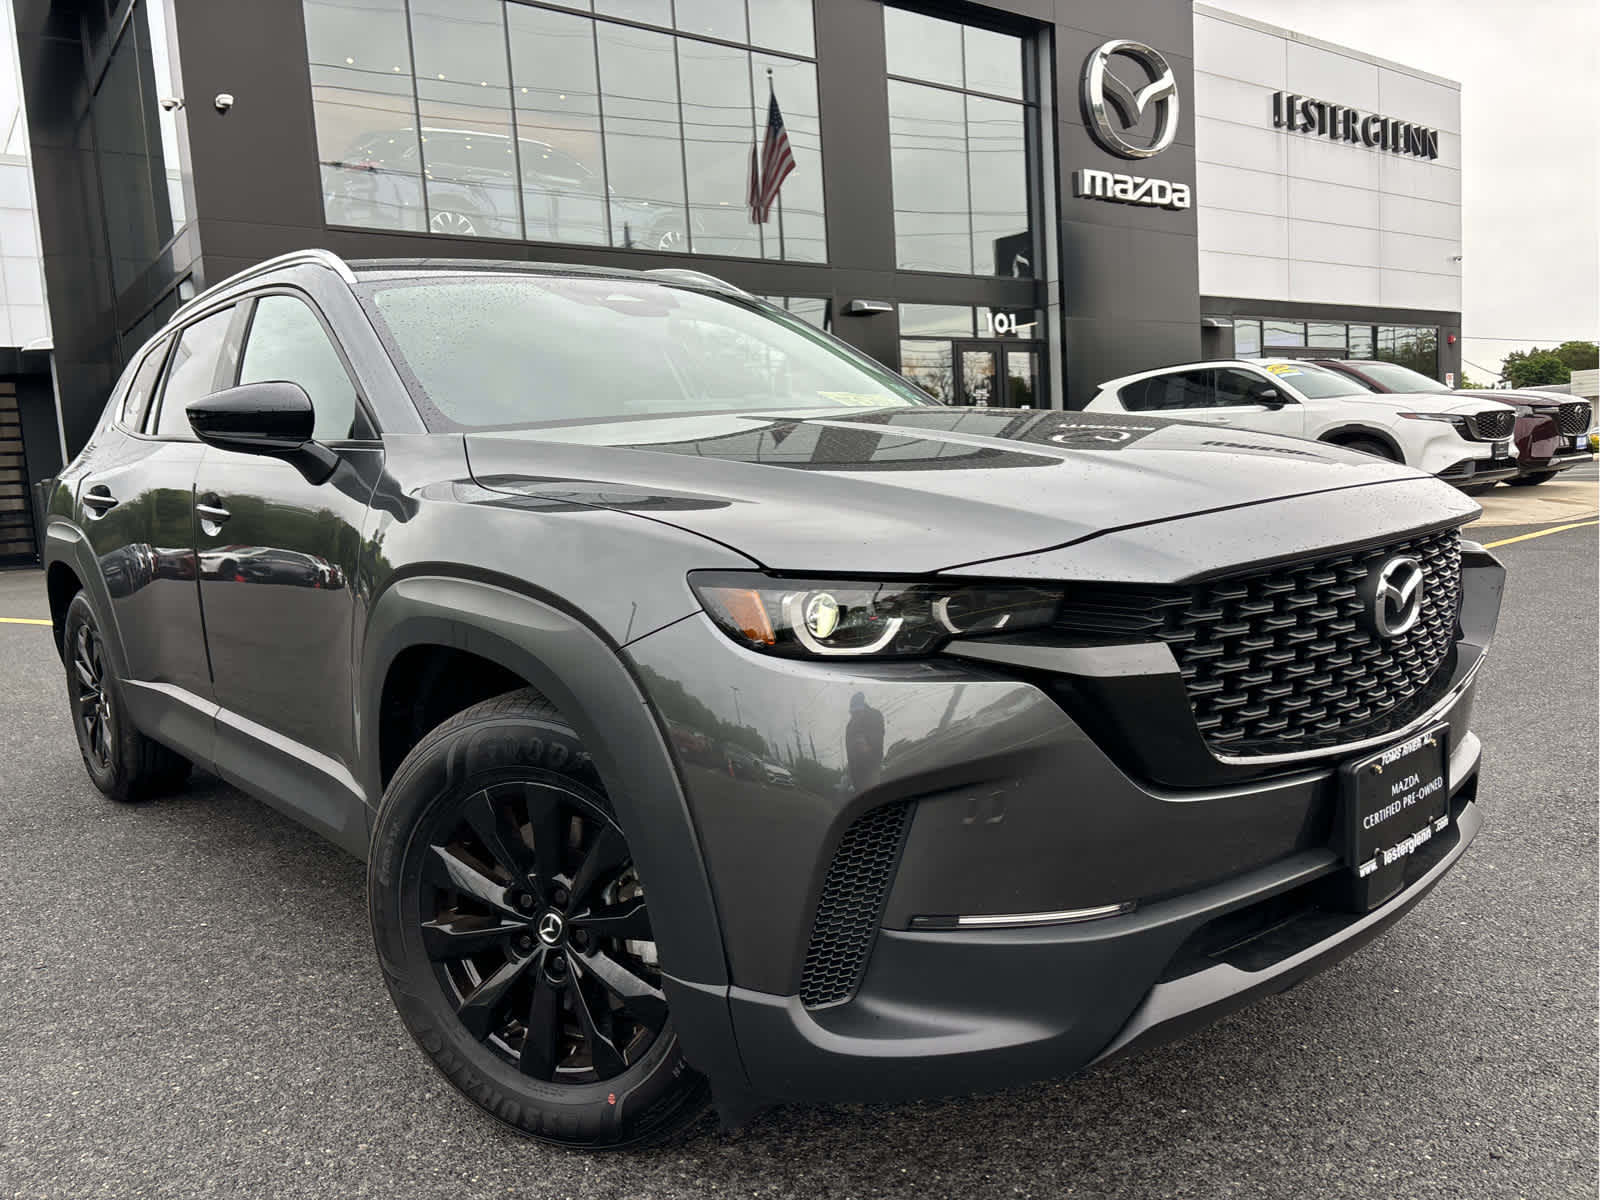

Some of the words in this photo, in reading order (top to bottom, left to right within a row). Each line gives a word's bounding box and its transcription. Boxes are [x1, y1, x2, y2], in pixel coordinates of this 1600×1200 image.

[986, 312, 1016, 334] 101
[1391, 773, 1420, 796] MAZDA
[1363, 801, 1401, 829] CERTIFIED
[1402, 776, 1443, 808] PRE-OWNED
[1382, 826, 1432, 865] lesterglenn
